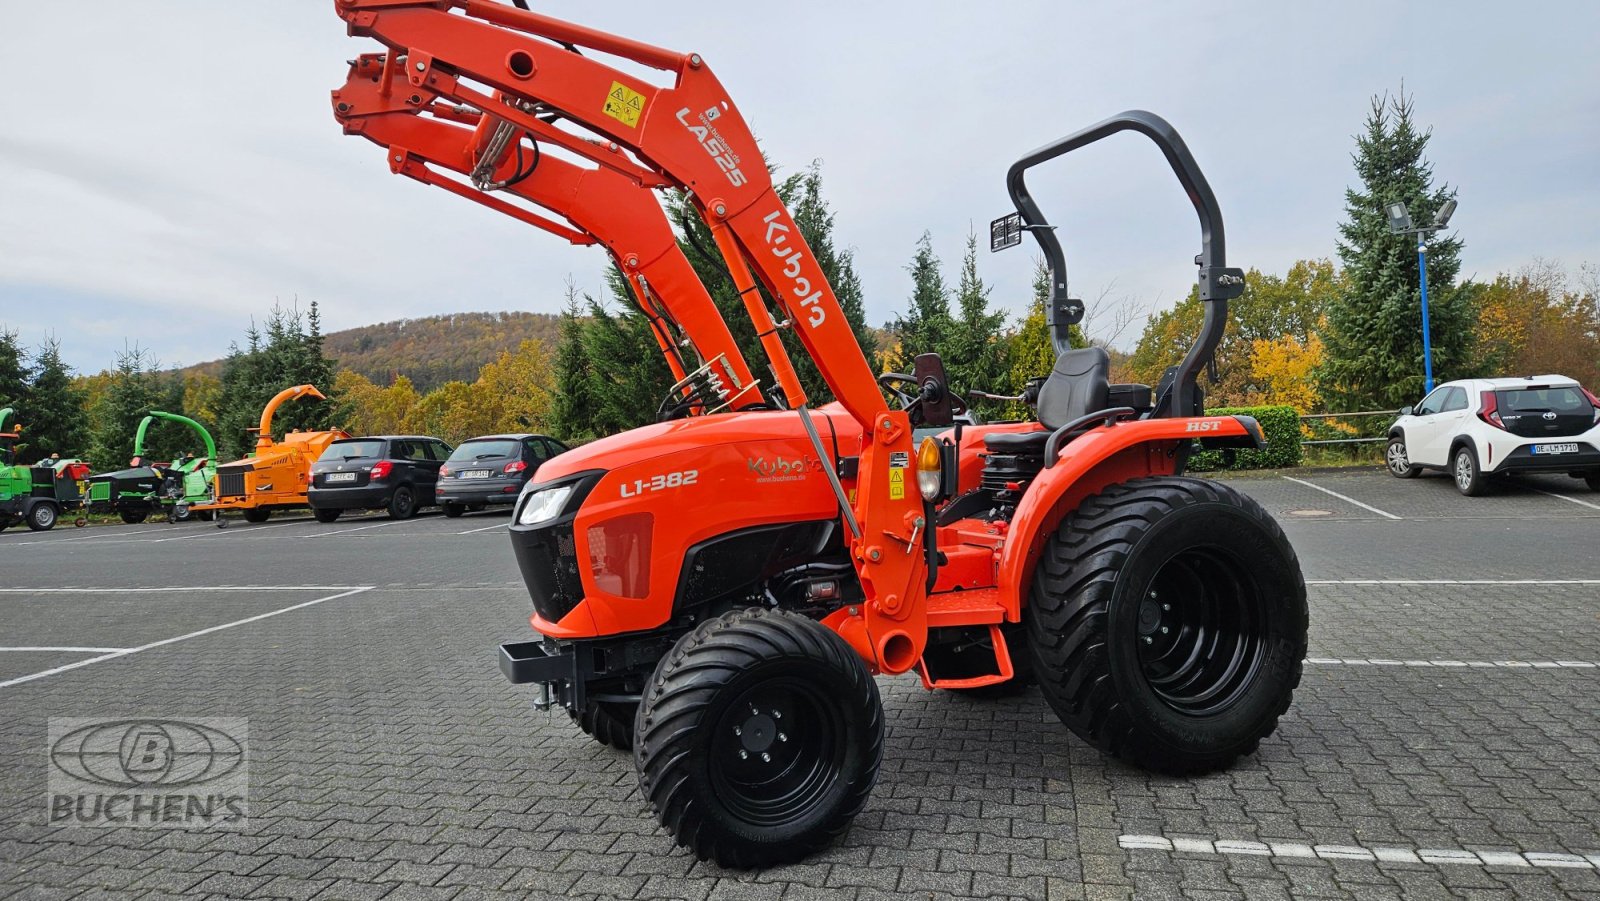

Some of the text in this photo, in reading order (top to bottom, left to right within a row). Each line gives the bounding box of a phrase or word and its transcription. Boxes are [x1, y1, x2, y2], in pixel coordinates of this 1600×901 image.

[675, 107, 748, 187] LA525
[698, 112, 740, 164] www.buchens.de
[763, 210, 826, 329] Kubota
[1185, 421, 1222, 432] HST
[620, 469, 699, 498] L1-382
